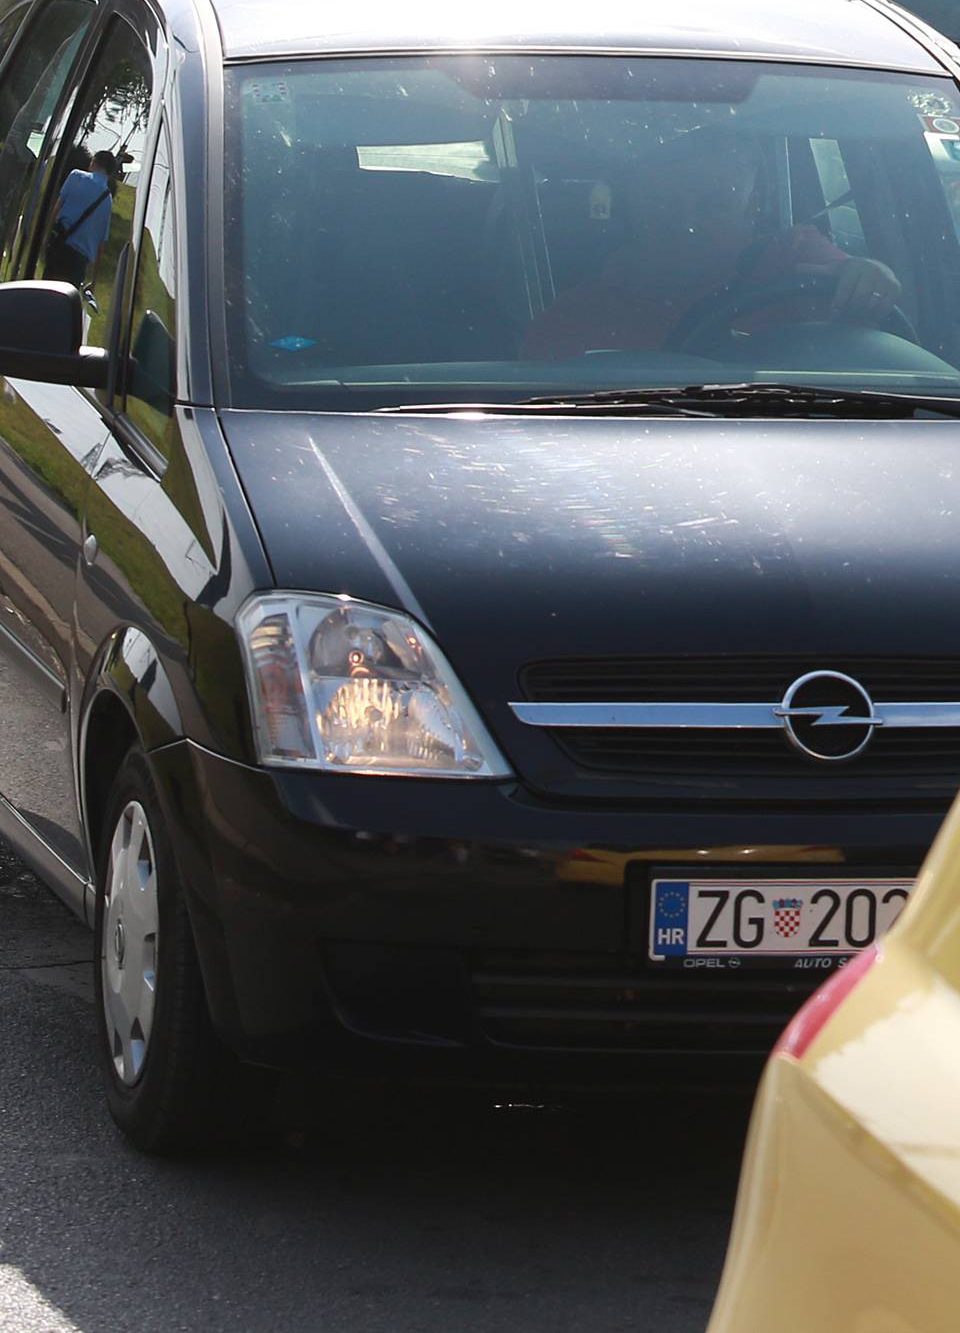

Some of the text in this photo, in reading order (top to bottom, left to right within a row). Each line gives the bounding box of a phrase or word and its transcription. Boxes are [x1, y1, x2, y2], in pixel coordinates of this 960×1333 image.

[696, 889, 766, 949] ZG
[657, 928, 685, 945] HR
[683, 958, 726, 968] OPEL
[794, 957, 833, 969] AUTO
